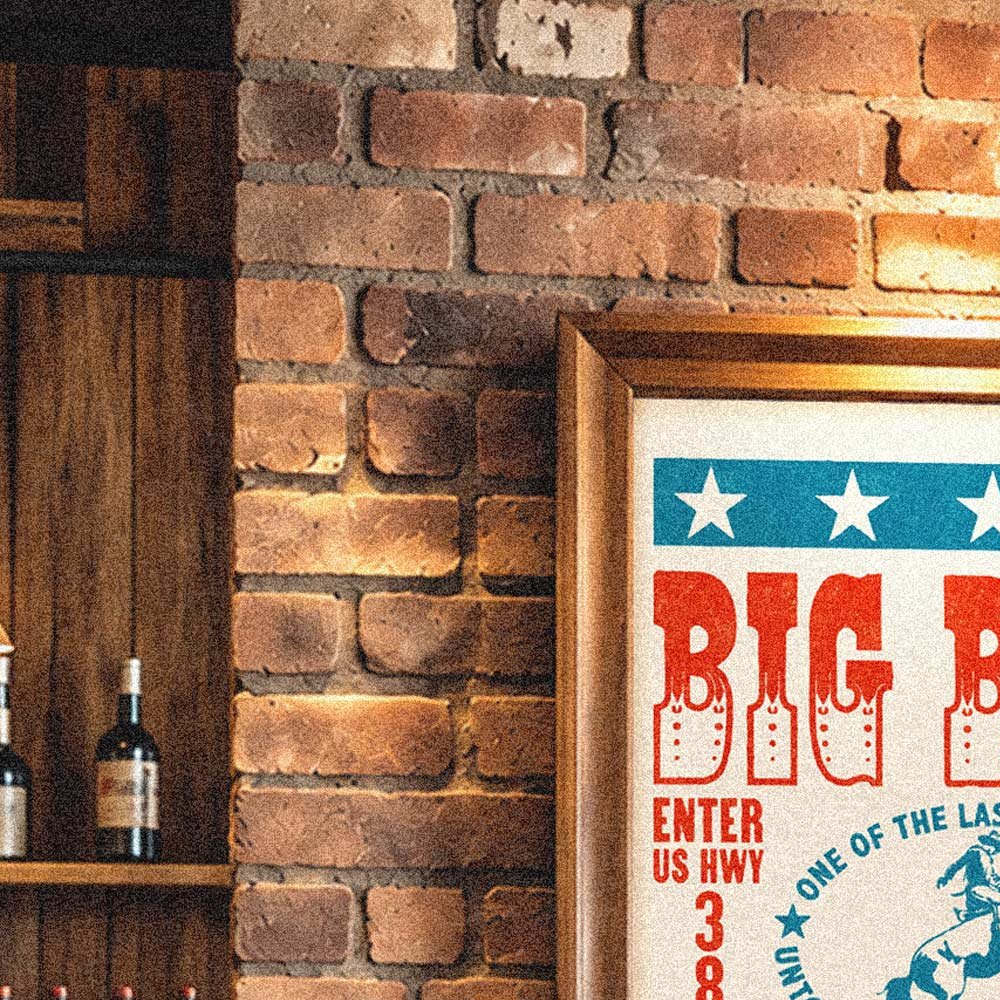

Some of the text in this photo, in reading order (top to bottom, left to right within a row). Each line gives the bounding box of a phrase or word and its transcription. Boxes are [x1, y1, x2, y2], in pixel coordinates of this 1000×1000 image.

[651, 568, 895, 789] BIG
[652, 796, 765, 845] ENTER
[796, 847, 848, 900] ONE
[850, 823, 884, 857] OF
[892, 806, 947, 839] THE
[652, 847, 765, 885] US HWY
